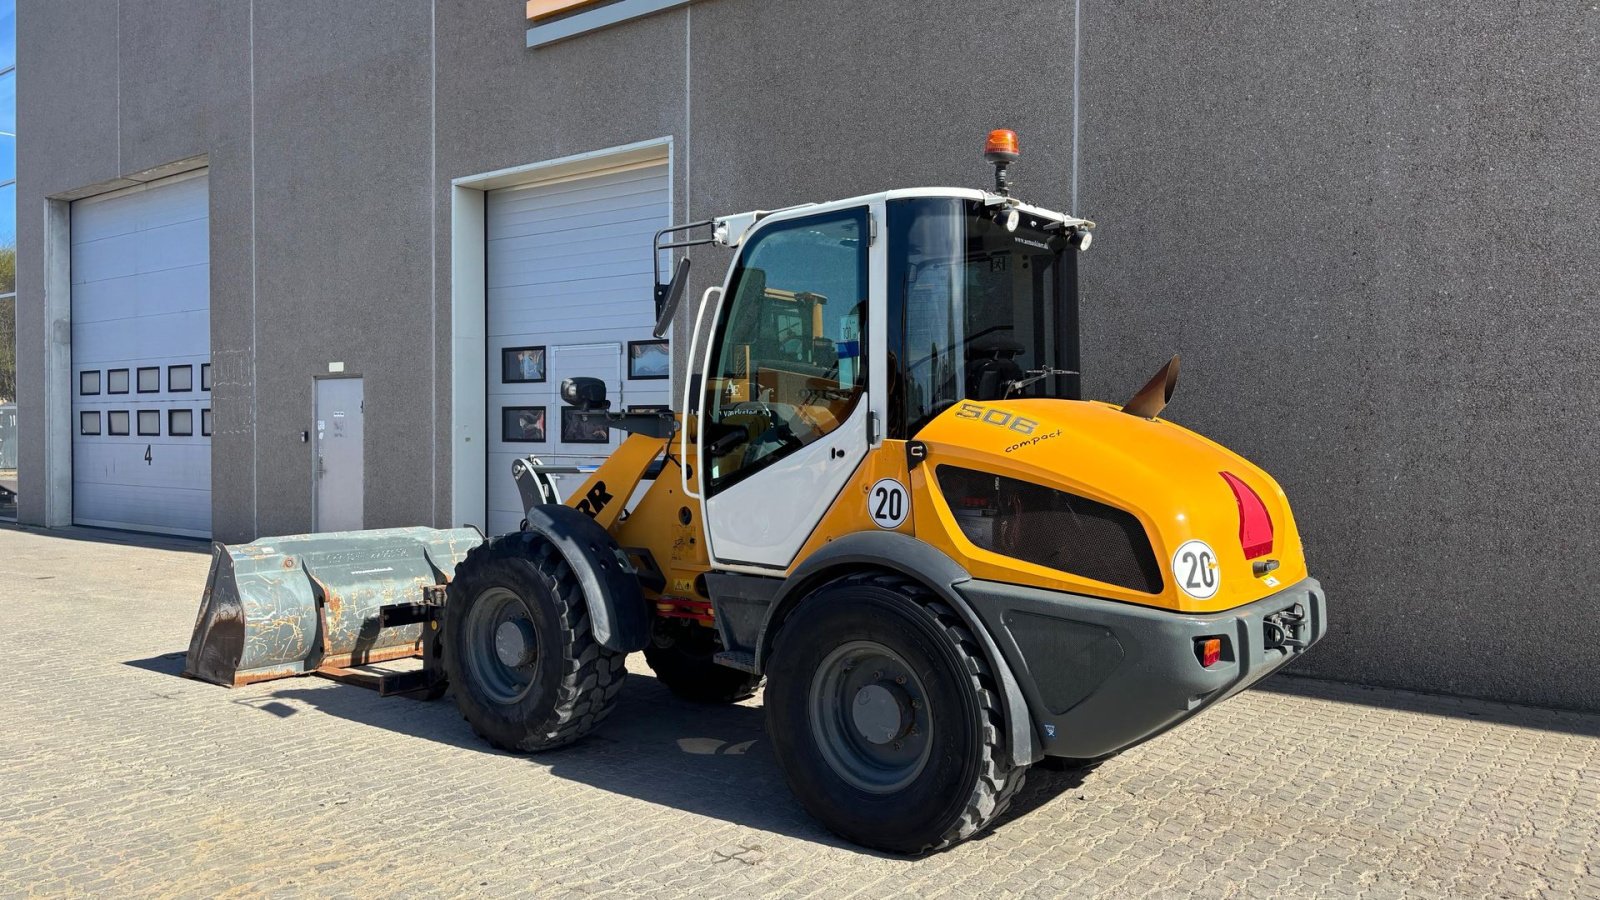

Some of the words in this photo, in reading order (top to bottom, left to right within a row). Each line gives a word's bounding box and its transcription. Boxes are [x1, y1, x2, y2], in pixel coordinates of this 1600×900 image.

[955, 402, 1041, 436] 506
[144, 444, 153, 466] 4
[1005, 429, 1063, 453] compact
[875, 486, 902, 521] 20
[1182, 551, 1215, 589] 20
